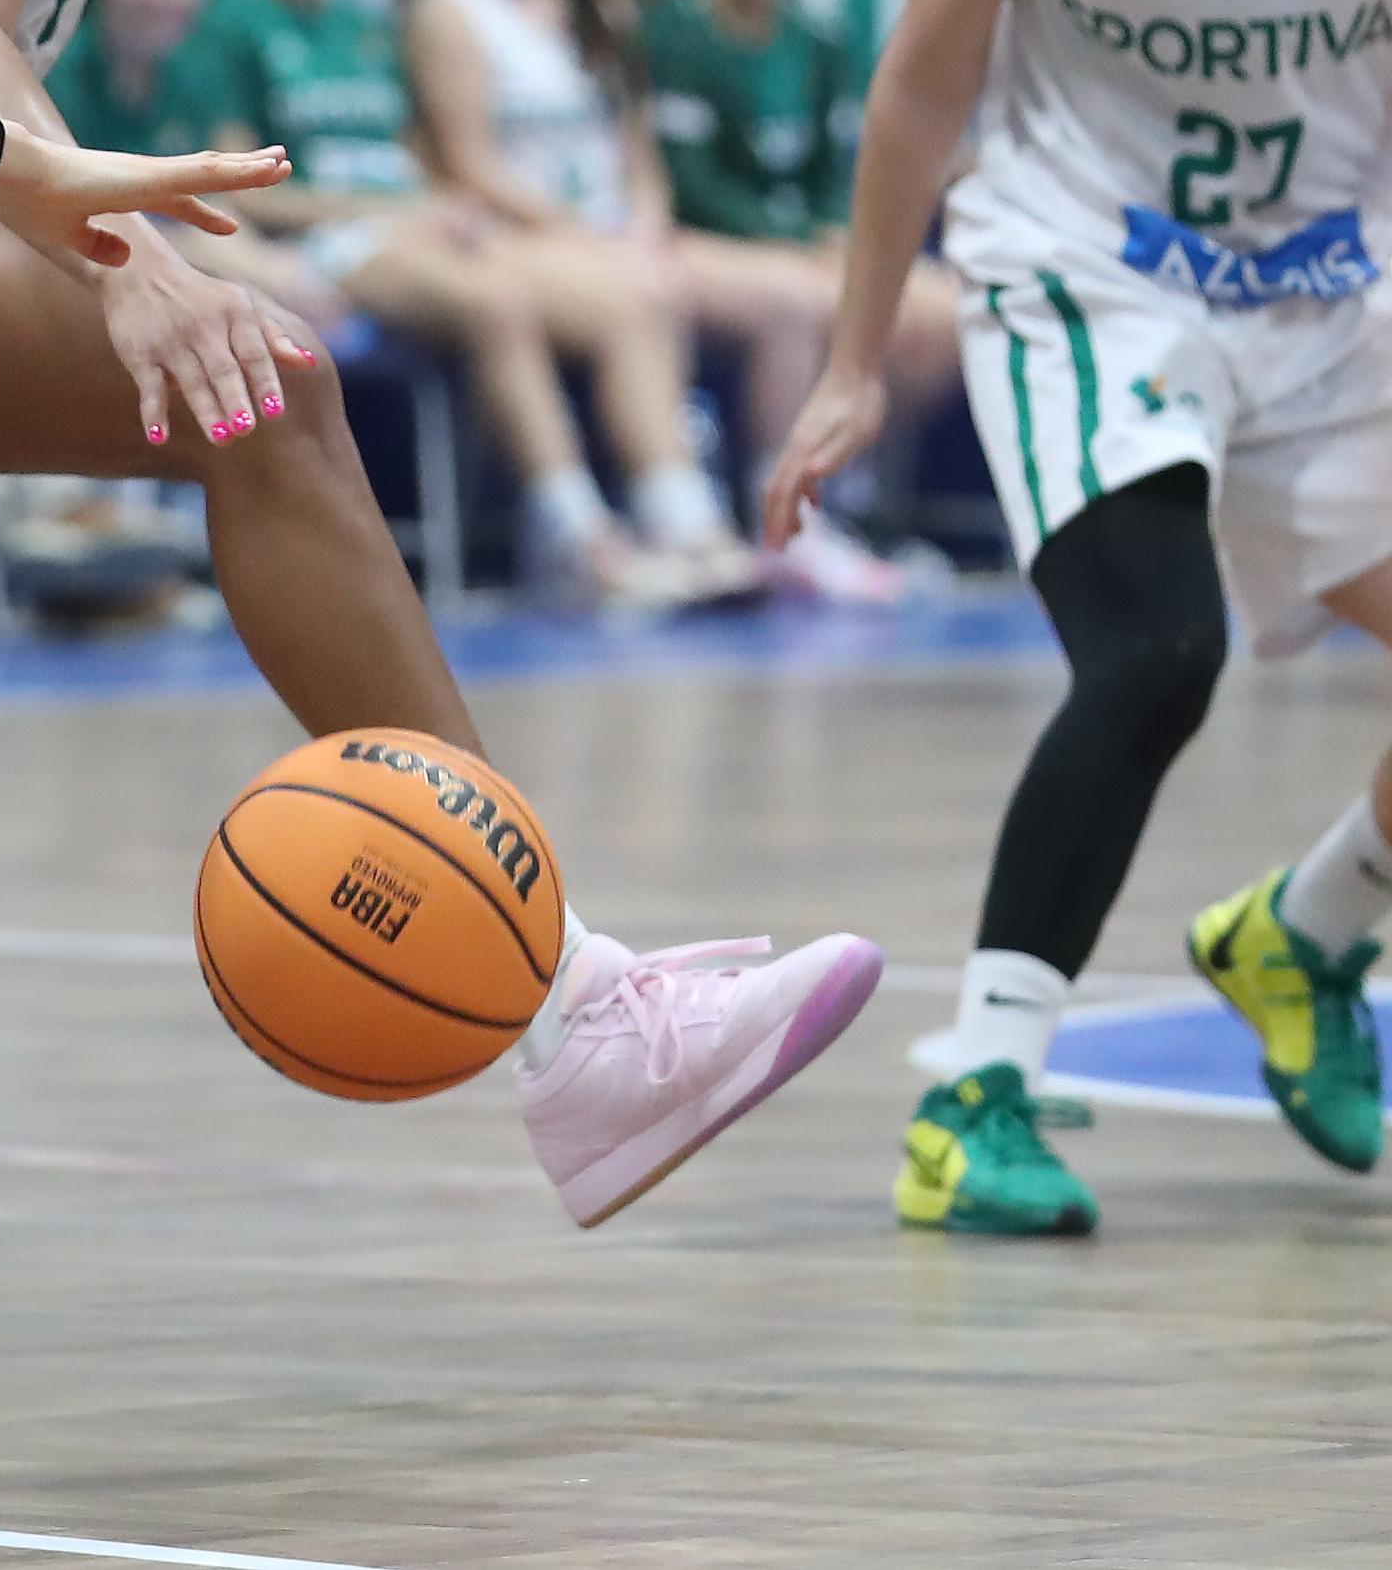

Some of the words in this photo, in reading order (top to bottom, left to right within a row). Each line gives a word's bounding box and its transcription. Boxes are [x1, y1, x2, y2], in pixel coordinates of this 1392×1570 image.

[1169, 108, 1306, 227] 27
[342, 742, 540, 903] Wilson
[329, 870, 414, 945] FIBA
